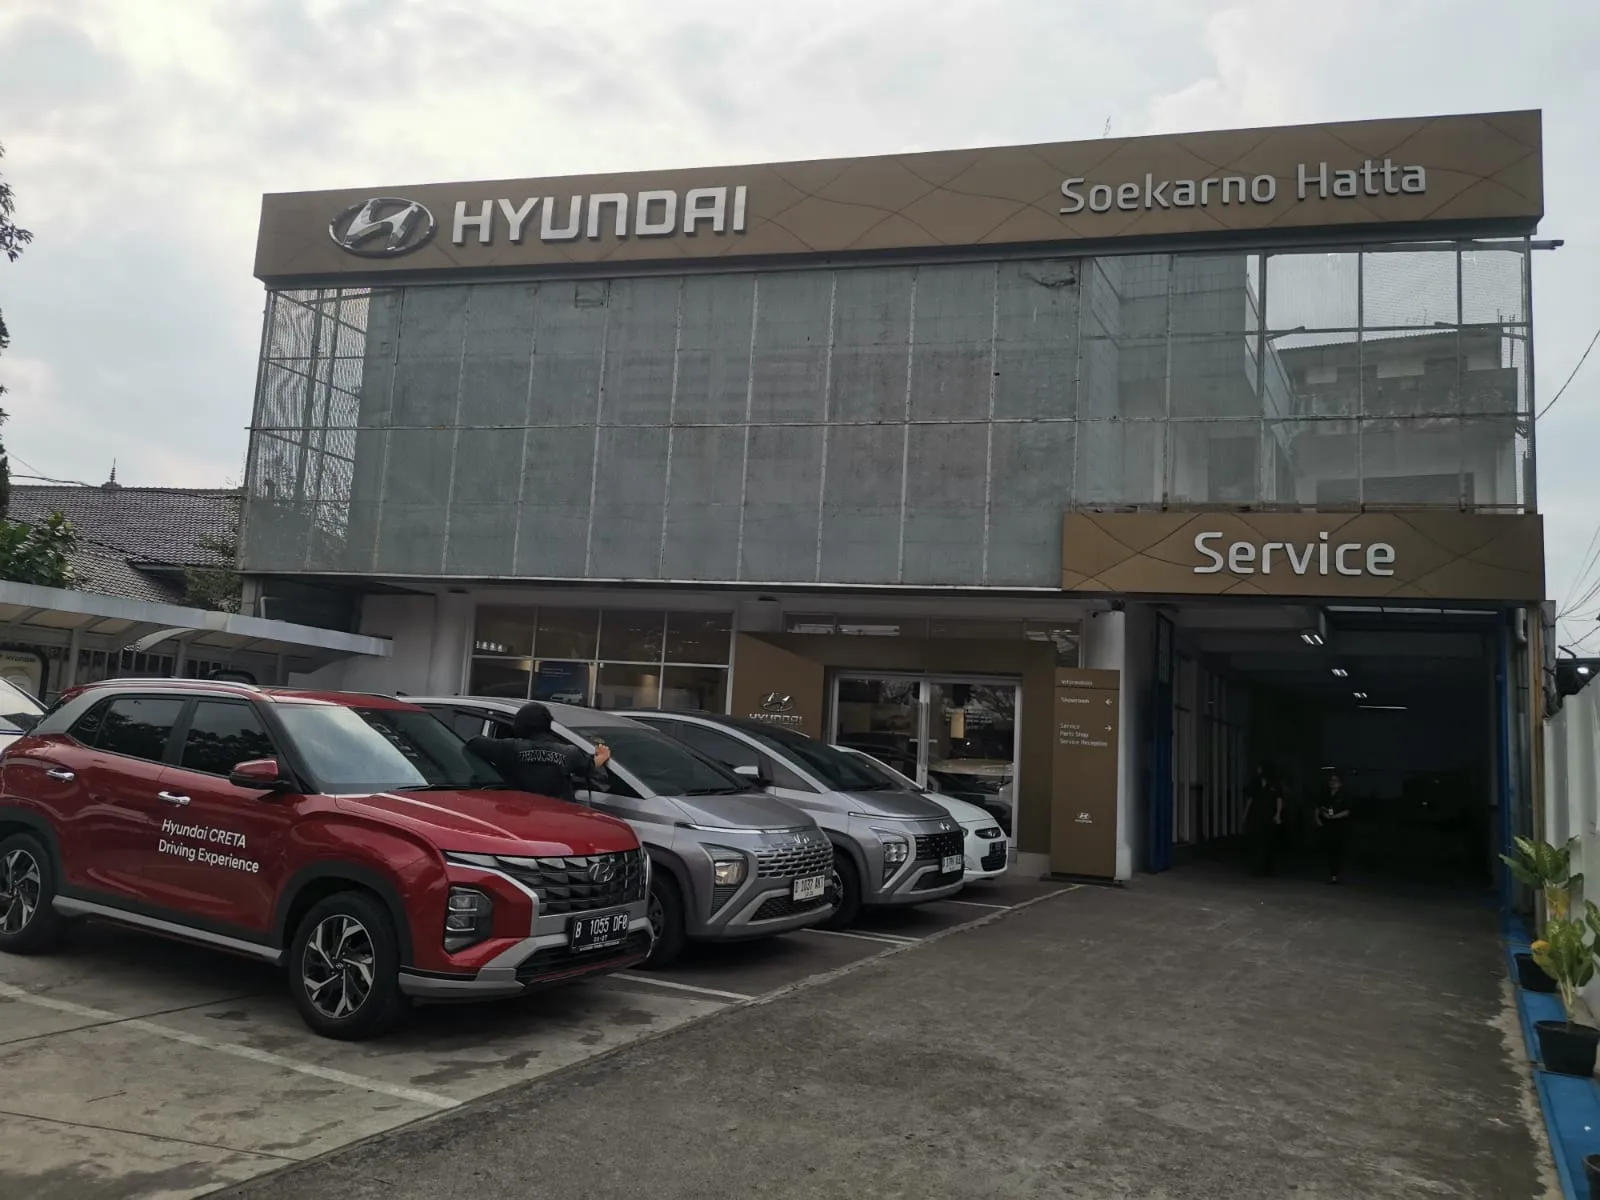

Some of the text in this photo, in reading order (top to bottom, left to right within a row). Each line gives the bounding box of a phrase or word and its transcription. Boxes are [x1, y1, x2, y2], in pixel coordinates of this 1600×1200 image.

[1060, 158, 1427, 214] Soekarno Hatta
[452, 186, 747, 243] HYUNDAI
[1193, 531, 1397, 577] Service
[161, 818, 246, 849] Hyundai CRETA
[158, 838, 260, 874] Driving Experience
[590, 916, 610, 936] 1055
